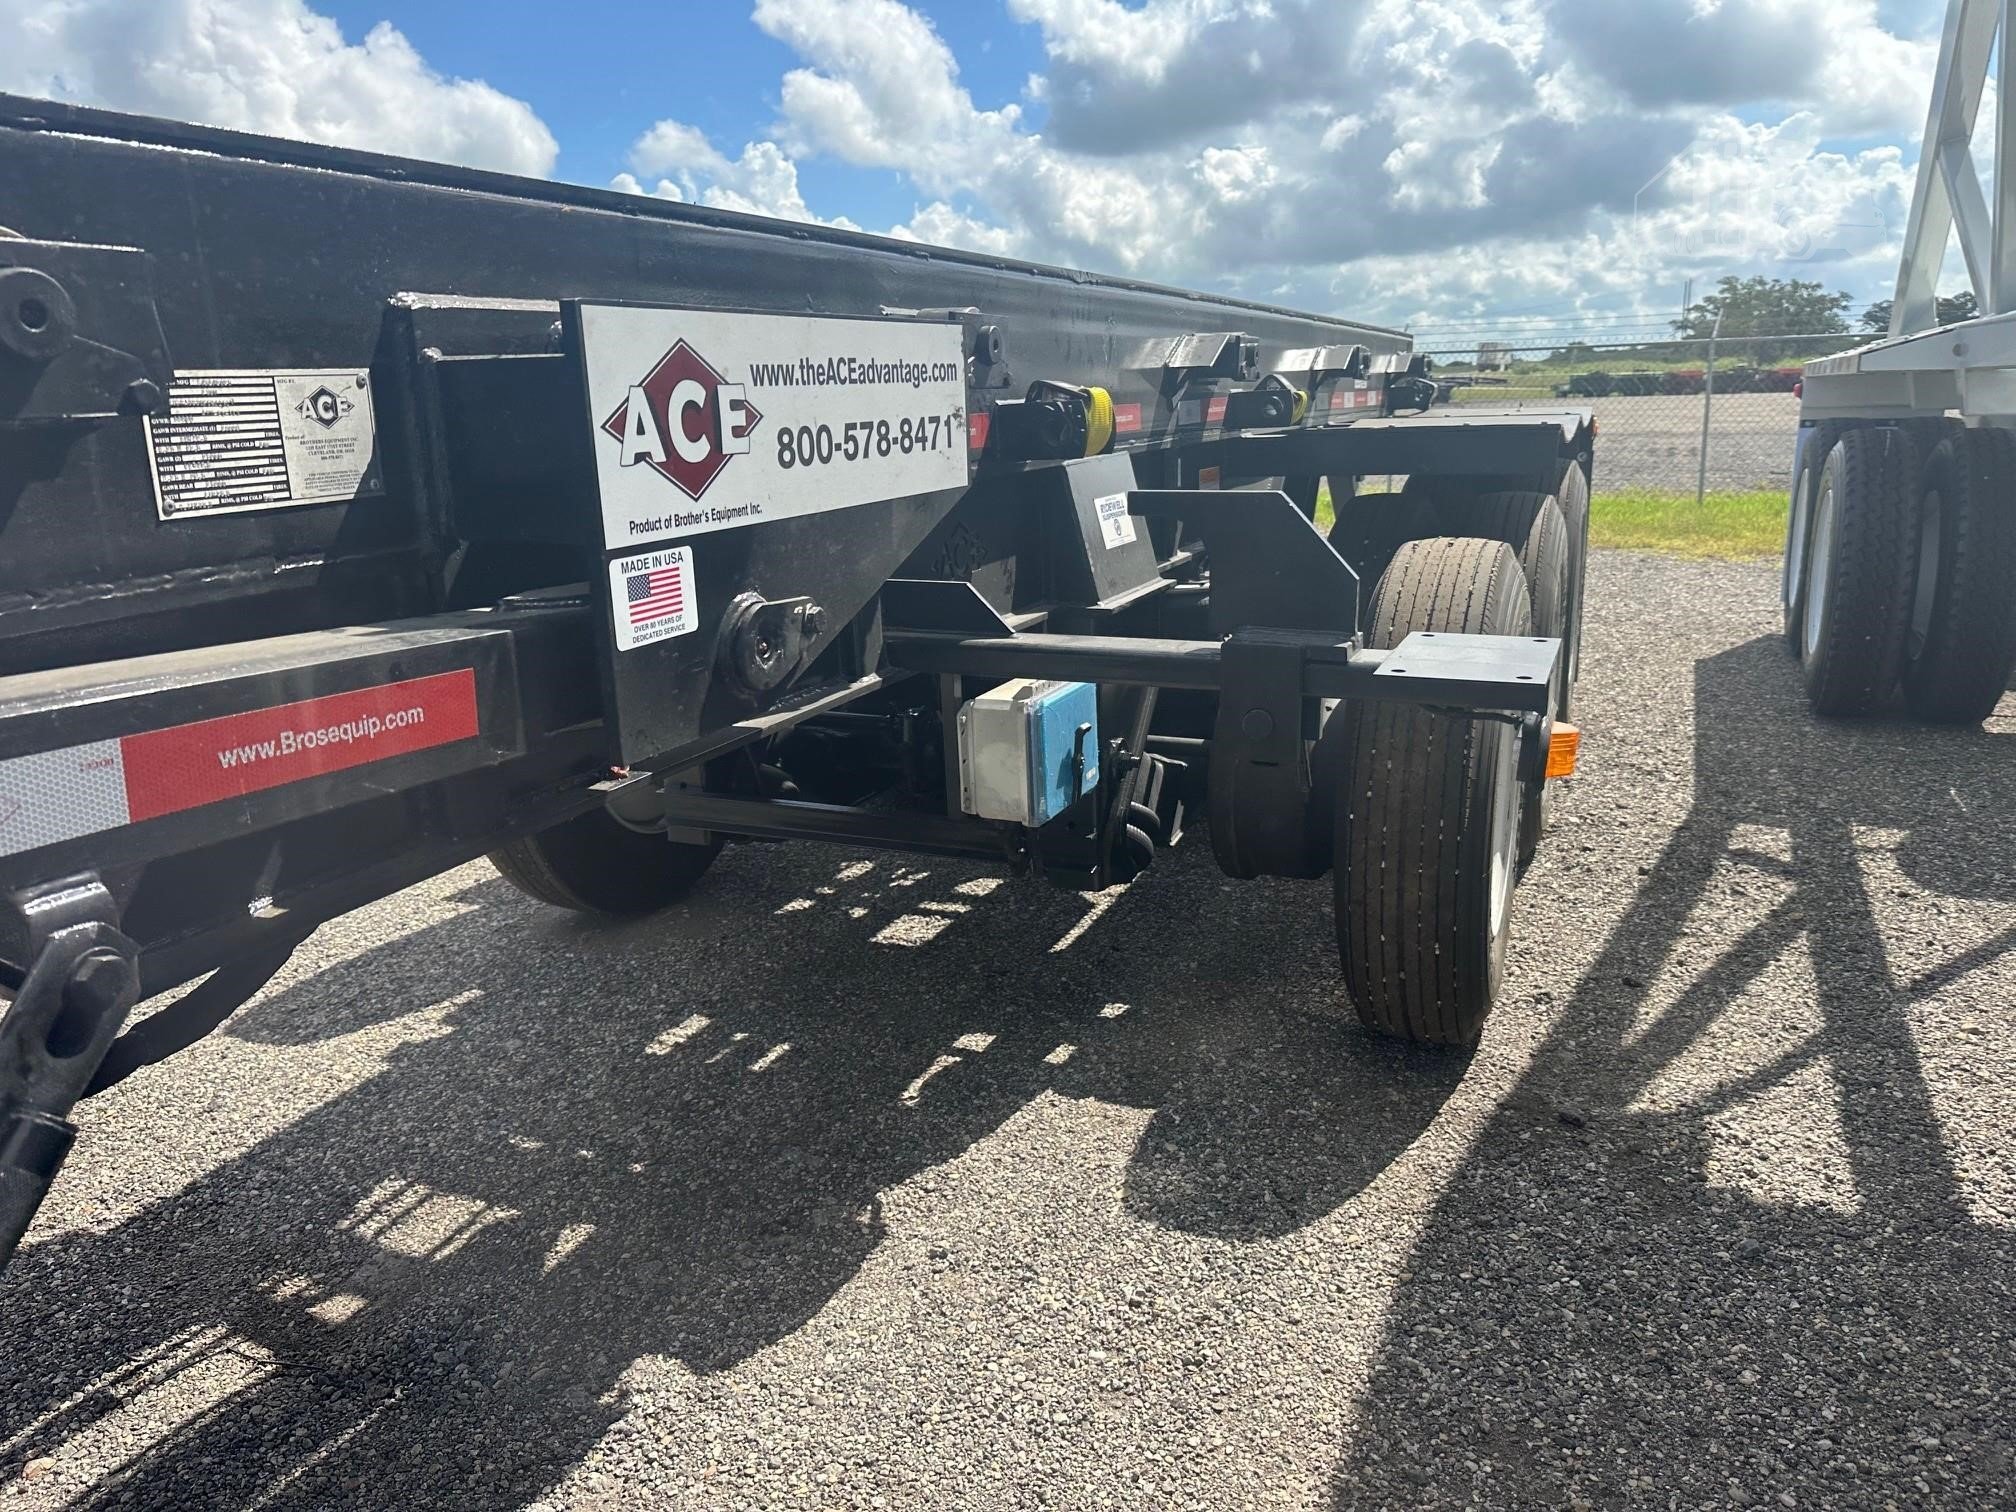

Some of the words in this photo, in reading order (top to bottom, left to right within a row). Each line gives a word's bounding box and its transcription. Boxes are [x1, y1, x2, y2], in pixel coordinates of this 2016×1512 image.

[750, 357, 958, 388] www.theACEadvantage.com
[301, 394, 350, 420] ACE
[620, 380, 750, 468] ACE
[778, 414, 954, 469] 800-578-8471
[629, 518, 662, 535] Product
[664, 516, 673, 530] of
[674, 509, 709, 528] Brother's
[710, 504, 748, 524] Equipment
[750, 502, 762, 515] Inc.
[621, 558, 650, 574] MADE
[652, 555, 662, 568] IN
[664, 551, 684, 565] USA
[632, 628, 663, 643] DEDICATED
[664, 624, 686, 636] SERVICE
[634, 623, 650, 633] OVER
[658, 617, 675, 627] YEARS
[218, 704, 425, 770] www.Brosequip.com
